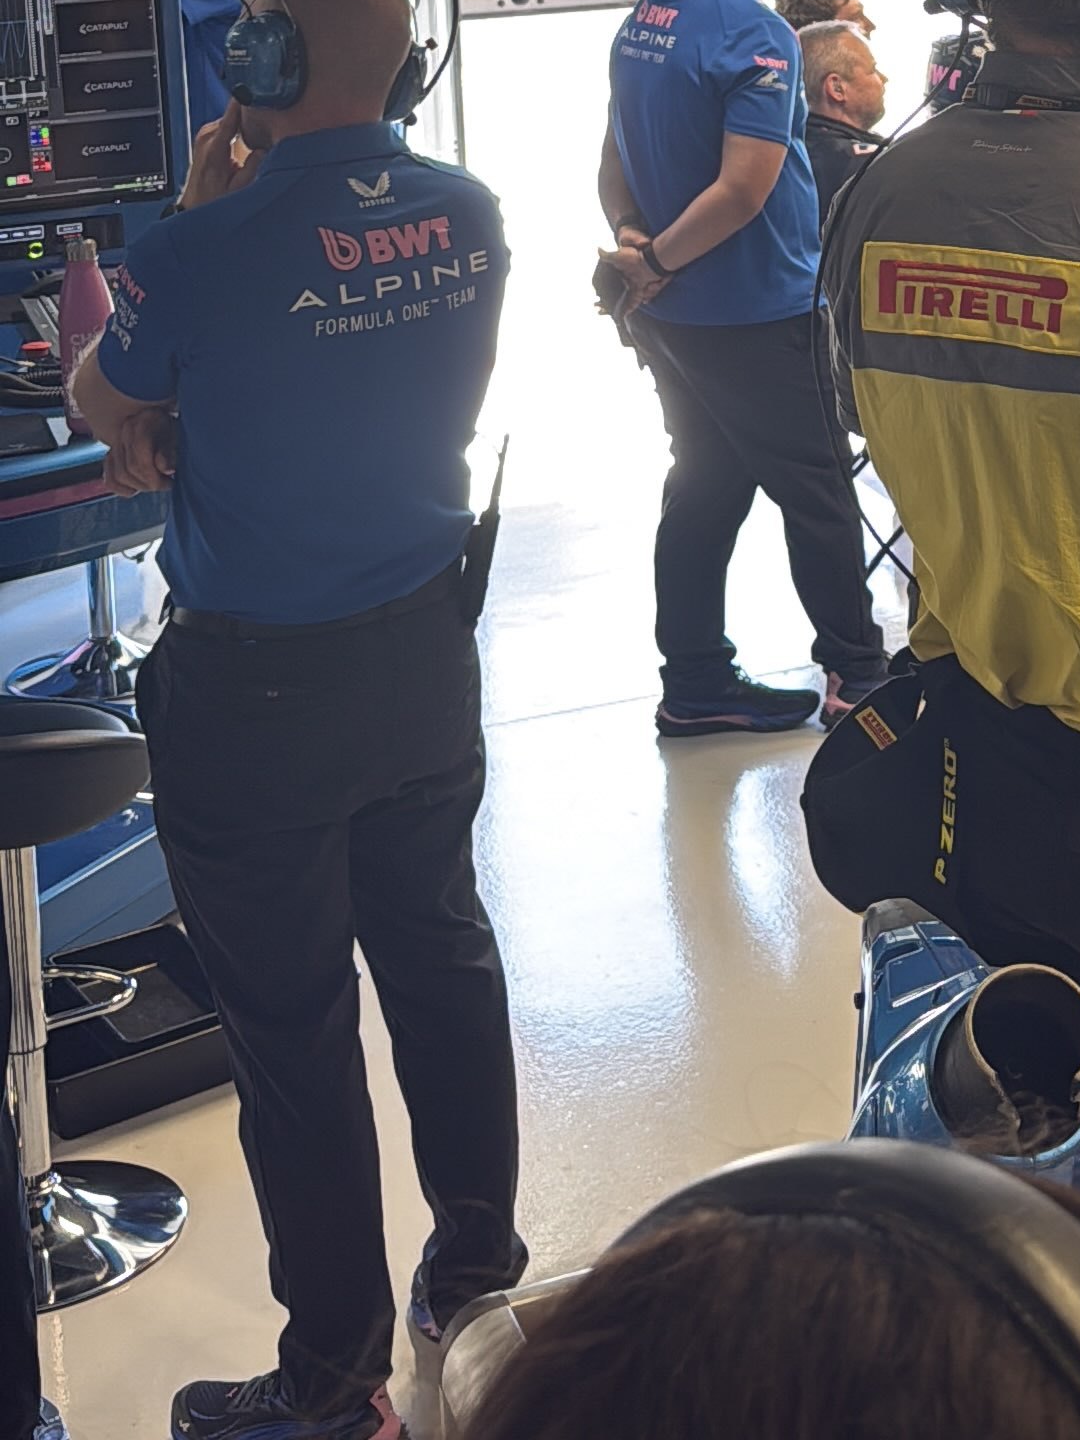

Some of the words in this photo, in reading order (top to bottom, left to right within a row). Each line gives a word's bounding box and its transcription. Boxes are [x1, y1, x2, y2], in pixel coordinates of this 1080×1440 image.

[86, 21, 128, 33] CATAPULT
[647, 5, 679, 29] BWT
[621, 29, 677, 49] ALPINE
[90, 80, 133, 92] CATAPULT
[88, 143, 131, 155] CATAPULT
[365, 216, 452, 265] BWT
[289, 250, 489, 313] ALPINE
[879, 260, 1068, 333] PIRELLI
[315, 310, 395, 337] FORMULA
[447, 286, 476, 310] TEAM
[934, 857, 947, 886] P
